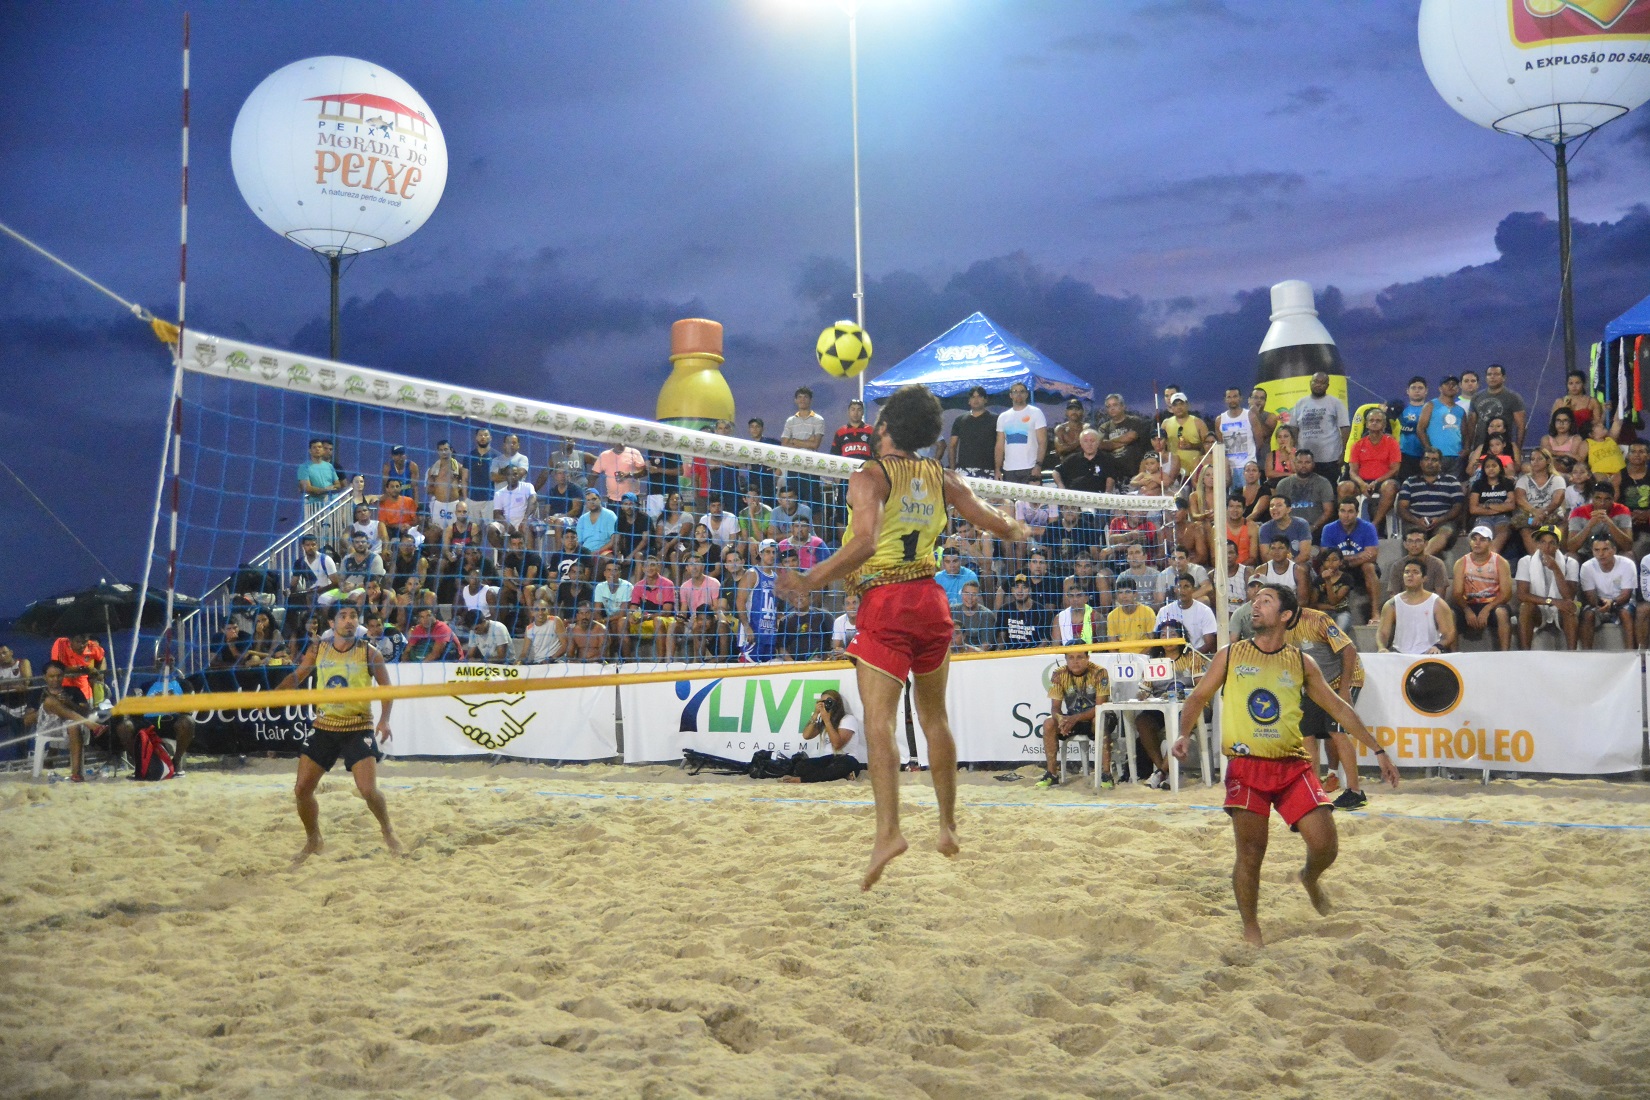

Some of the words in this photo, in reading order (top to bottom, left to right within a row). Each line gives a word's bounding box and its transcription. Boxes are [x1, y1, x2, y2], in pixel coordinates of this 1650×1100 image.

[1525, 61, 1533, 71] A
[1537, 51, 1605, 69] EXPLOSÃO
[1607, 52, 1625, 63] DO
[1627, 52, 1650, 65] SAB
[318, 121, 428, 150] PEIXARIA
[317, 132, 399, 158] MORADA
[406, 150, 427, 167] DO
[321, 187, 327, 195] A
[328, 189, 360, 199] natureza
[900, 529, 920, 562] 1
[455, 666, 500, 677] AMIGOS
[503, 668, 519, 677] DO
[1117, 666, 1134, 678] 10
[1148, 664, 1166, 677] 10
[255, 722, 289, 742] Hair
[727, 740, 820, 751] ACADEMI
